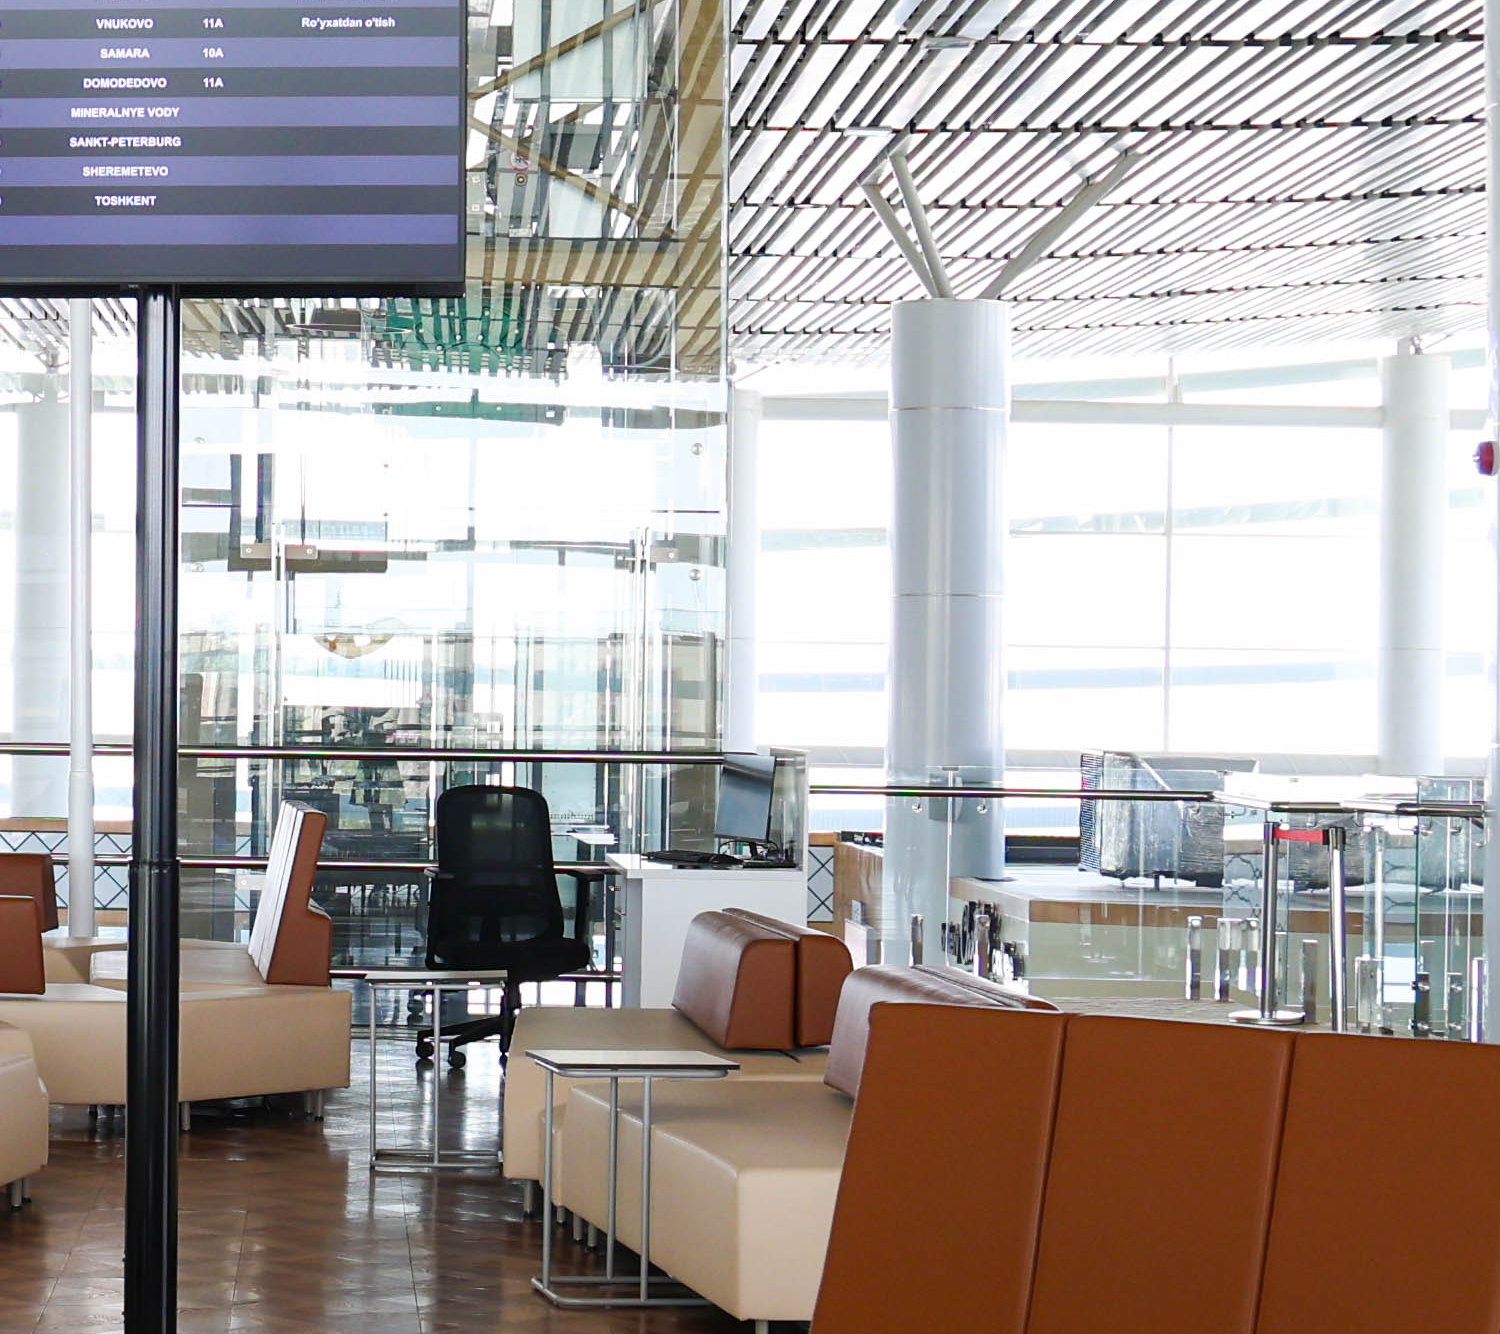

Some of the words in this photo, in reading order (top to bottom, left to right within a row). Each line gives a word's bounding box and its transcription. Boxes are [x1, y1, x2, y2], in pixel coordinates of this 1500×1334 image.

[96, 18, 154, 29] VNUKOVO
[203, 18, 224, 28] 11A
[100, 48, 150, 59] SAMARA
[202, 47, 224, 59] 10A
[83, 77, 167, 89] DOMODEDOVO
[202, 77, 224, 88] 11A
[70, 107, 145, 119] MINERALNYE
[147, 107, 180, 118] VODY
[69, 135, 182, 148] SANKT-PETERBURG
[82, 165, 169, 177] SHEREMETEVO
[94, 195, 156, 207] TOSHKENT
